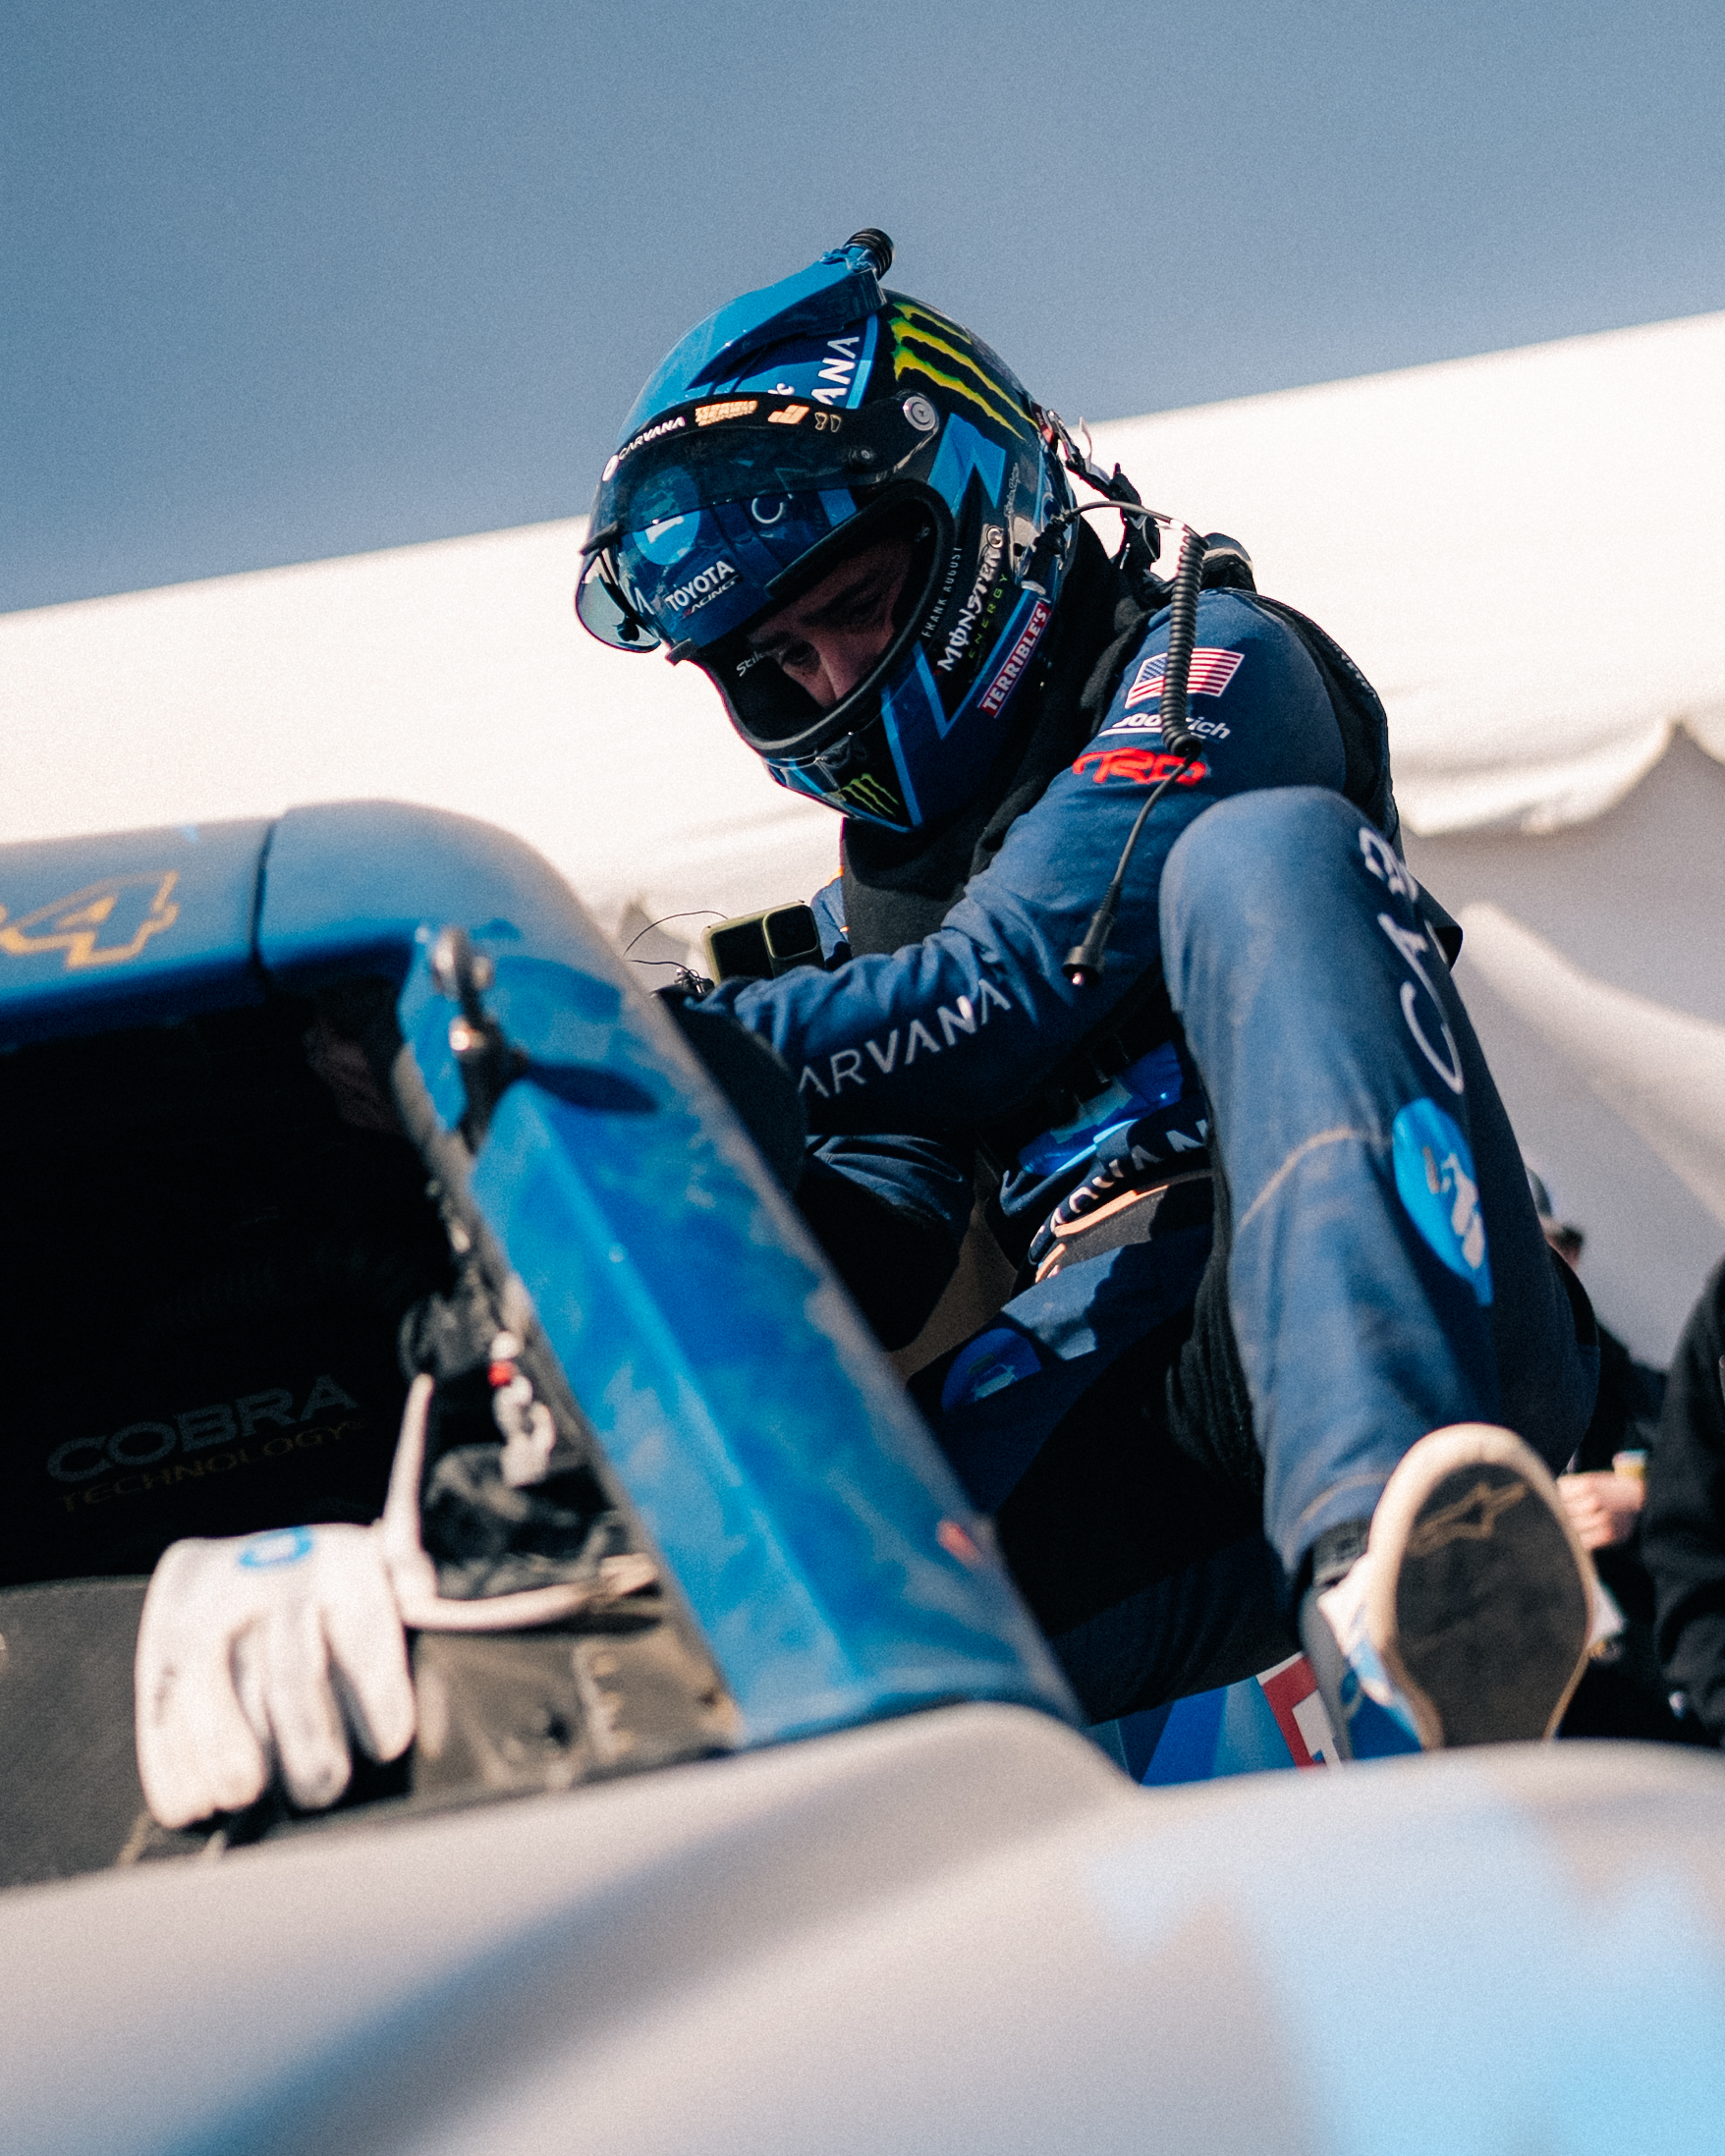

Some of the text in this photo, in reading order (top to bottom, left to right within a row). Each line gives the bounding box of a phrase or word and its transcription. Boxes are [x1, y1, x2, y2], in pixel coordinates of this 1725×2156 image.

[618, 416, 686, 461] CARVANA
[665, 560, 736, 612] TOYOTA
[968, 574, 1008, 659] ENERGY
[982, 607, 1049, 713] TERRIBLE'S
[1072, 746, 1207, 787] TRD
[0, 869, 180, 969] 4
[798, 977, 1013, 1099] ARVANA
[46, 1374, 362, 1484] COBRA
[56, 1418, 362, 1514] TECHNOLOGY
